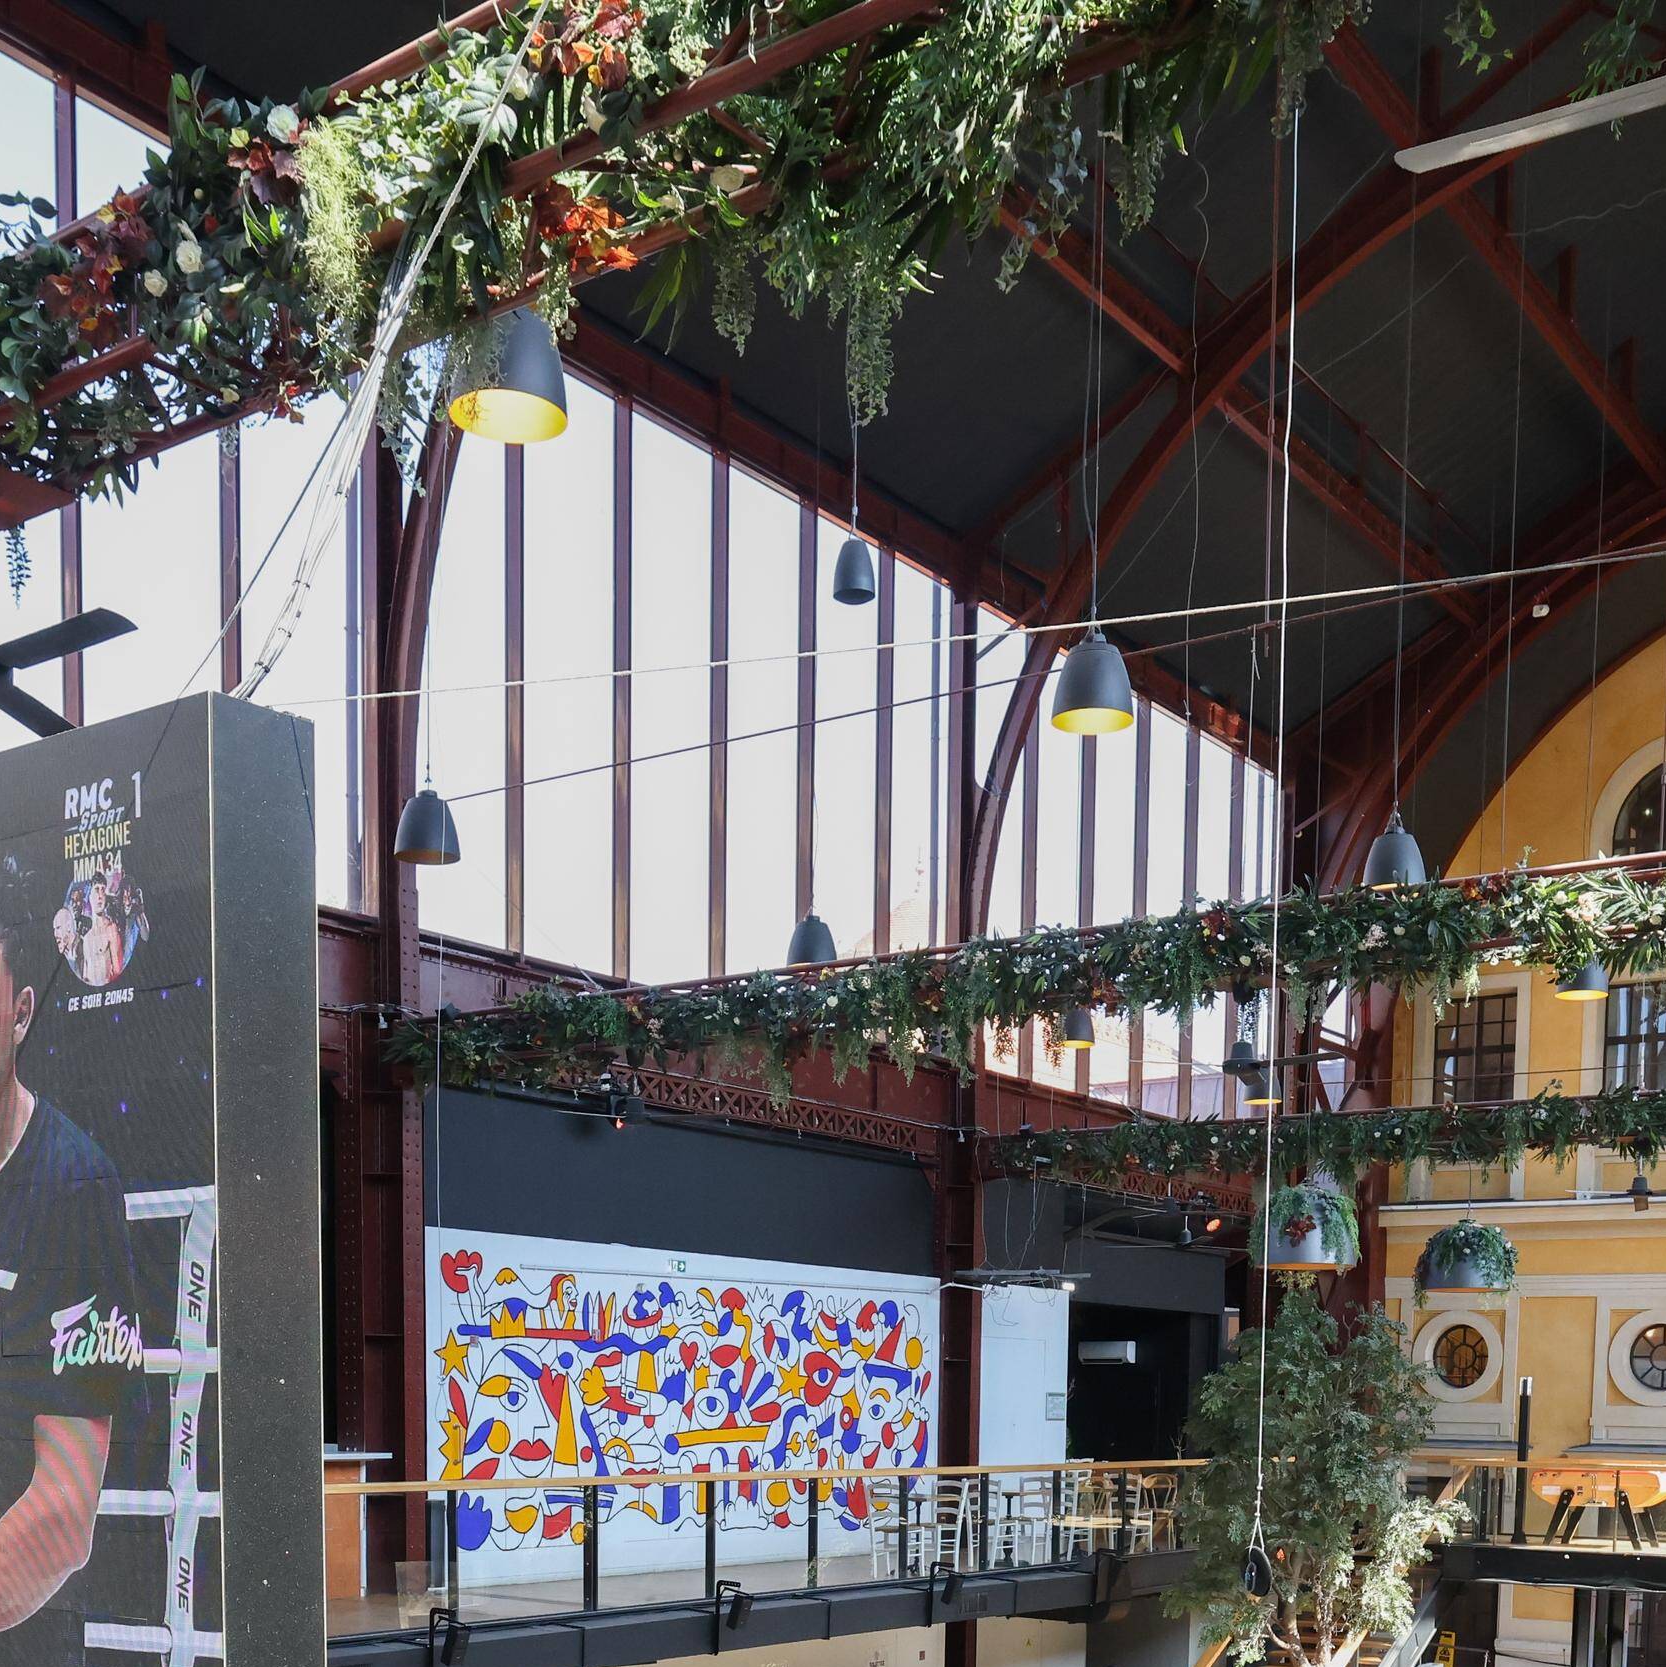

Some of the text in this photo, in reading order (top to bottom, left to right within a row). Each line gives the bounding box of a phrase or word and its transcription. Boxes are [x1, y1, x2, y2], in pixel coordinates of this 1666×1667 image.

[64, 770, 142, 820] RMC 1
[78, 806, 124, 832] SPORT
[64, 820, 131, 860] HEXAGONE
[73, 850, 123, 883] MMA 34
[68, 987, 134, 1012] CE SOIR 20H45
[186, 1260, 206, 1328] ONE
[50, 1293, 145, 1376] Fairtex
[181, 1410, 193, 1472] ONE
[175, 1555, 191, 1615] ONE
